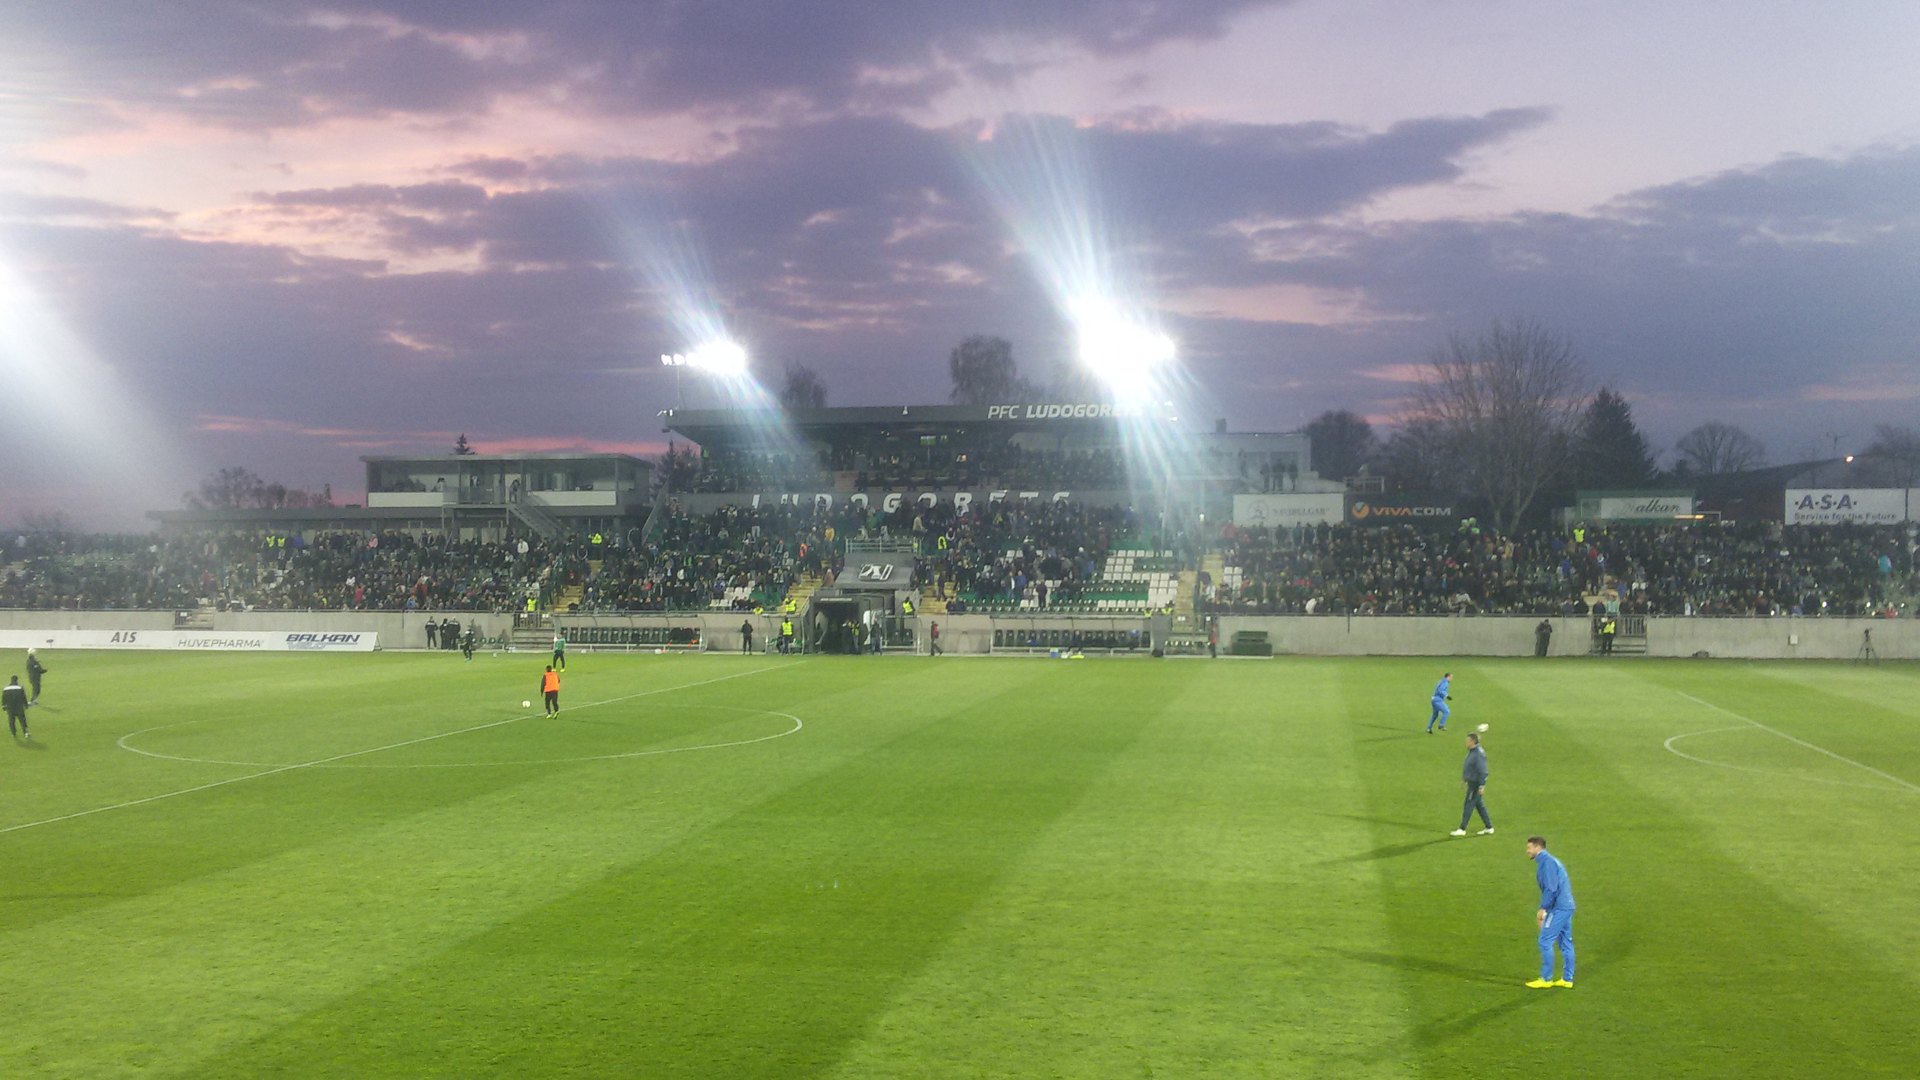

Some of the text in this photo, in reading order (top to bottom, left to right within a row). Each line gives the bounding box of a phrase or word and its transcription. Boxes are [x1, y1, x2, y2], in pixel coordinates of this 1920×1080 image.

[988, 404, 1143, 419] PFC LUDOGORE
[1622, 498, 1680, 512] alkan
[1373, 507, 1451, 516] VIVACOM
[111, 631, 137, 643] AIS
[286, 634, 360, 642] BALKAN
[178, 639, 261, 648] HUVEPHARMA
